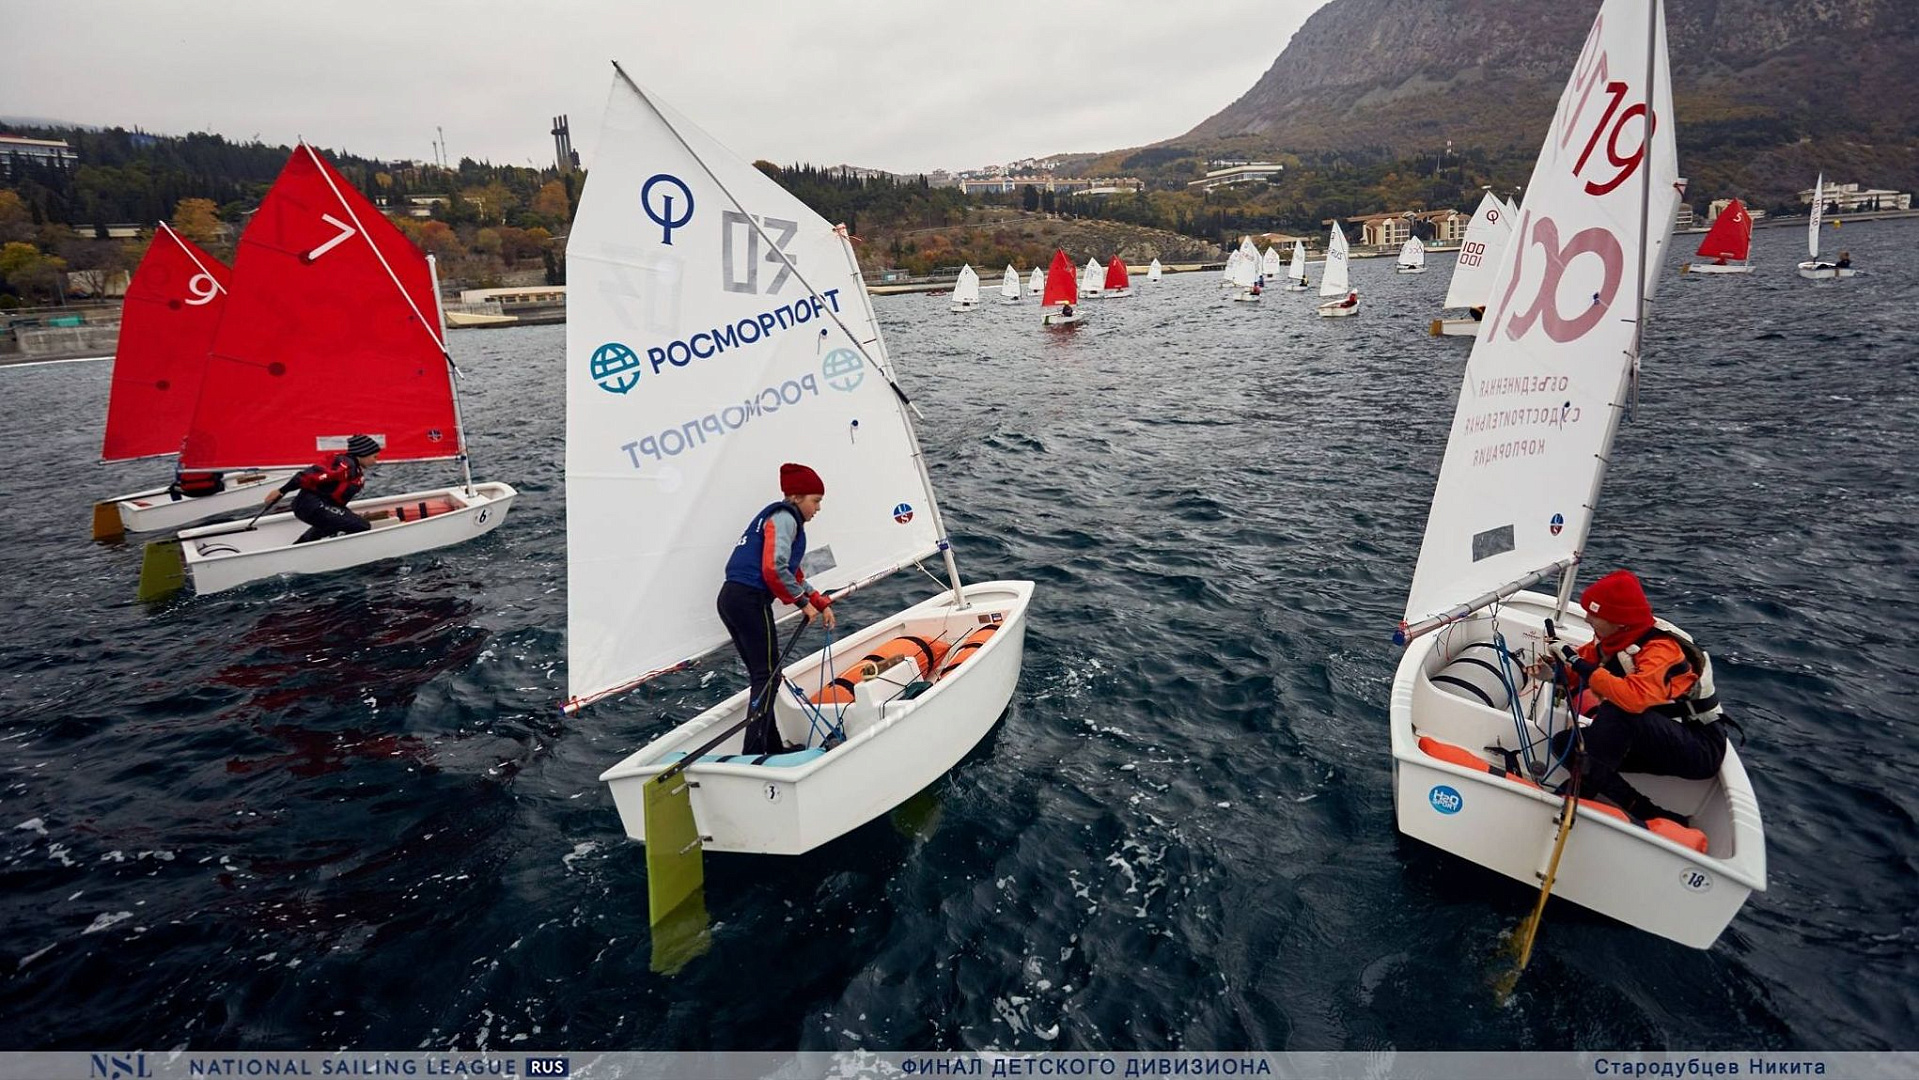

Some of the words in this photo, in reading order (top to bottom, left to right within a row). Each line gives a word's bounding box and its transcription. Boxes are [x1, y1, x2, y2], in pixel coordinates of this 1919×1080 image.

[1572, 82, 1657, 196] 19
[308, 213, 357, 261] 7
[1463, 241, 1486, 255] 100
[184, 273, 219, 306] 9
[647, 289, 840, 375] РОСМОРПОРТ
[479, 509, 487, 523] 6
[1687, 872, 1705, 888] 18
